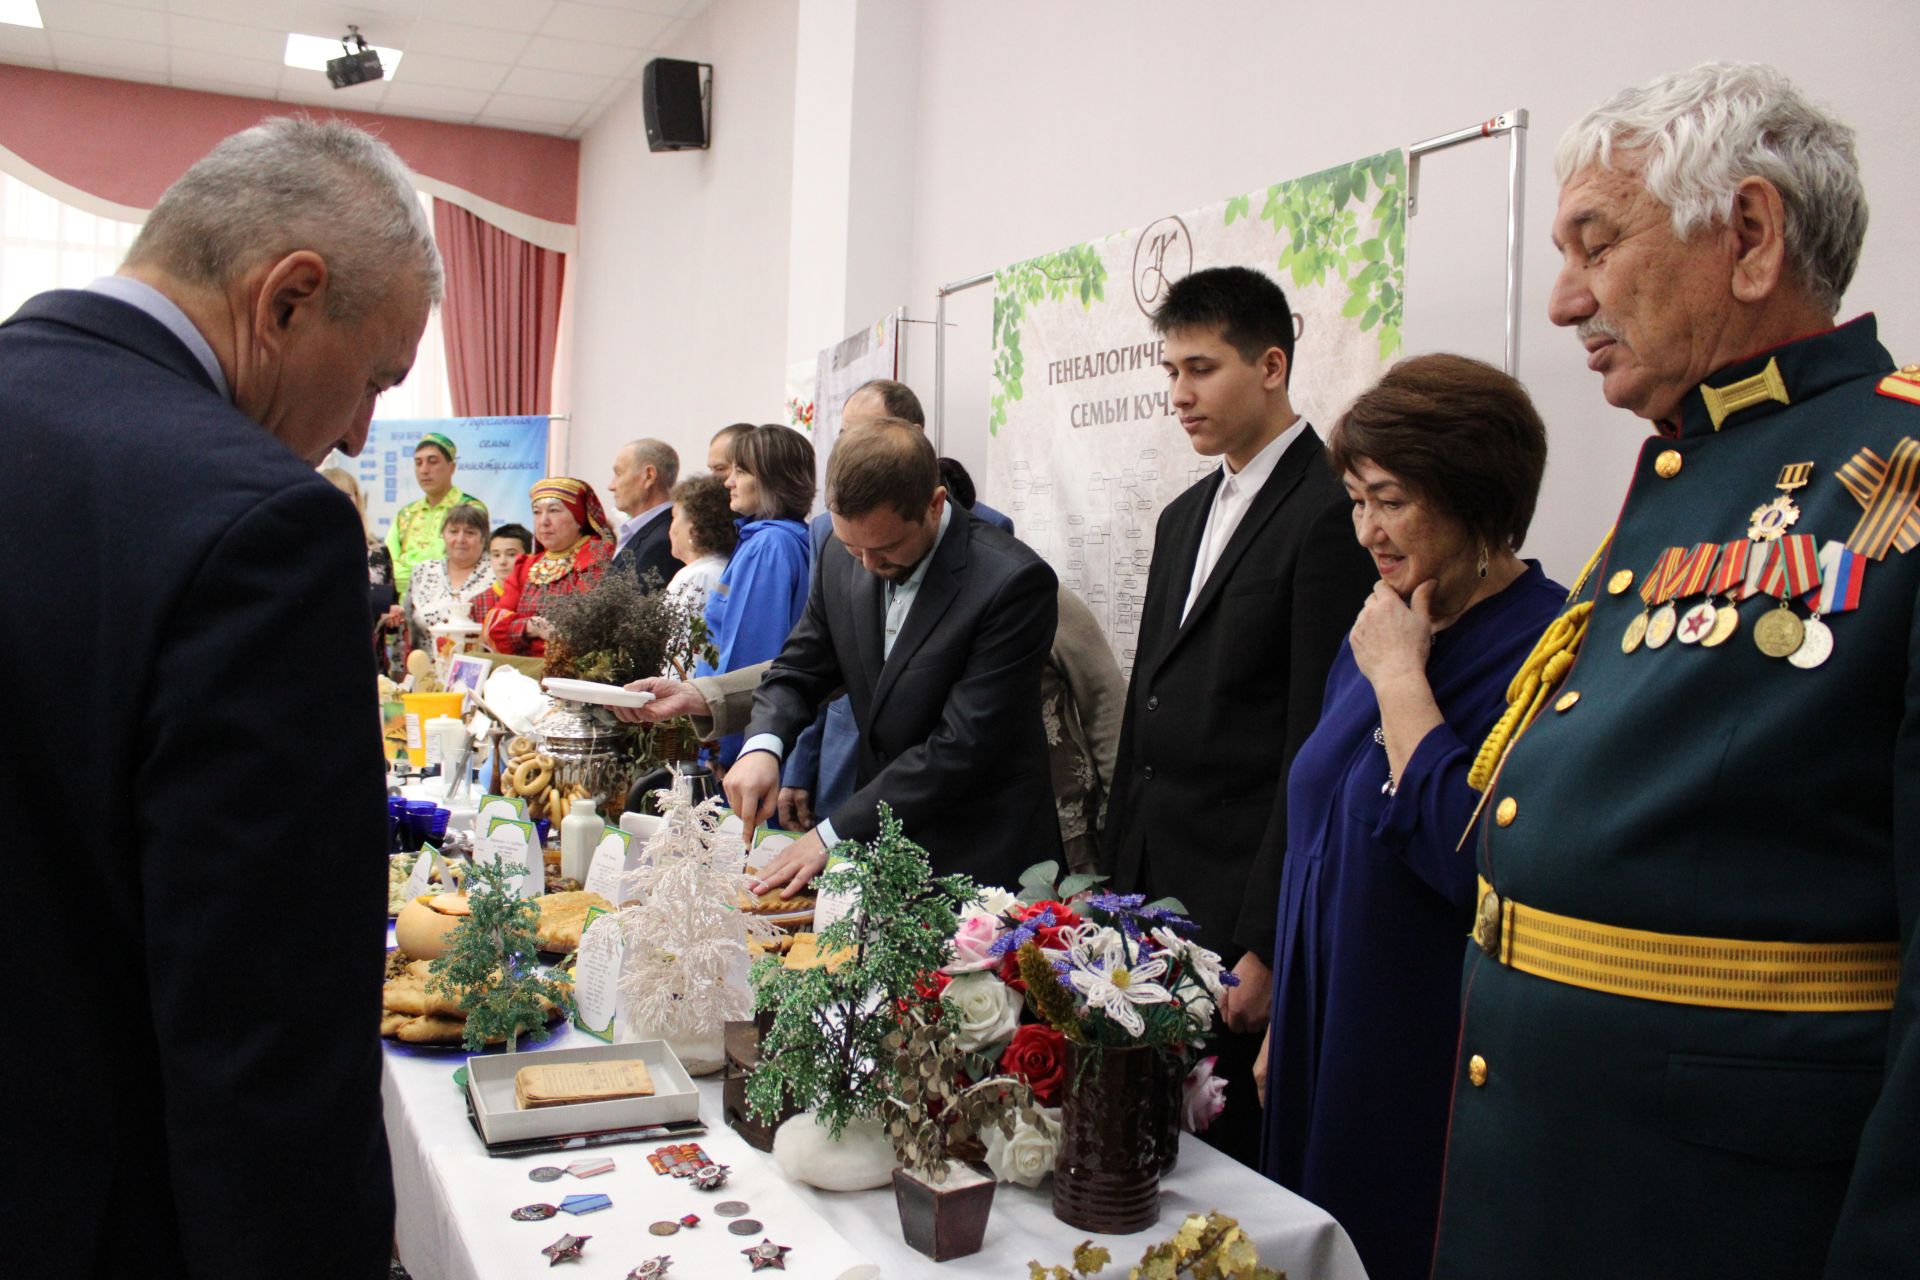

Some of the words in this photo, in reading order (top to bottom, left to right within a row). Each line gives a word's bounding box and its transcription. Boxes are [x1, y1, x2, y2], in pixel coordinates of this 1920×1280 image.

[1048, 340, 1165, 386] ГЕНЕАЛОГИЧЕ
[1070, 396, 1128, 428] СЕМЬИ
[1134, 390, 1176, 421] КУЧ
